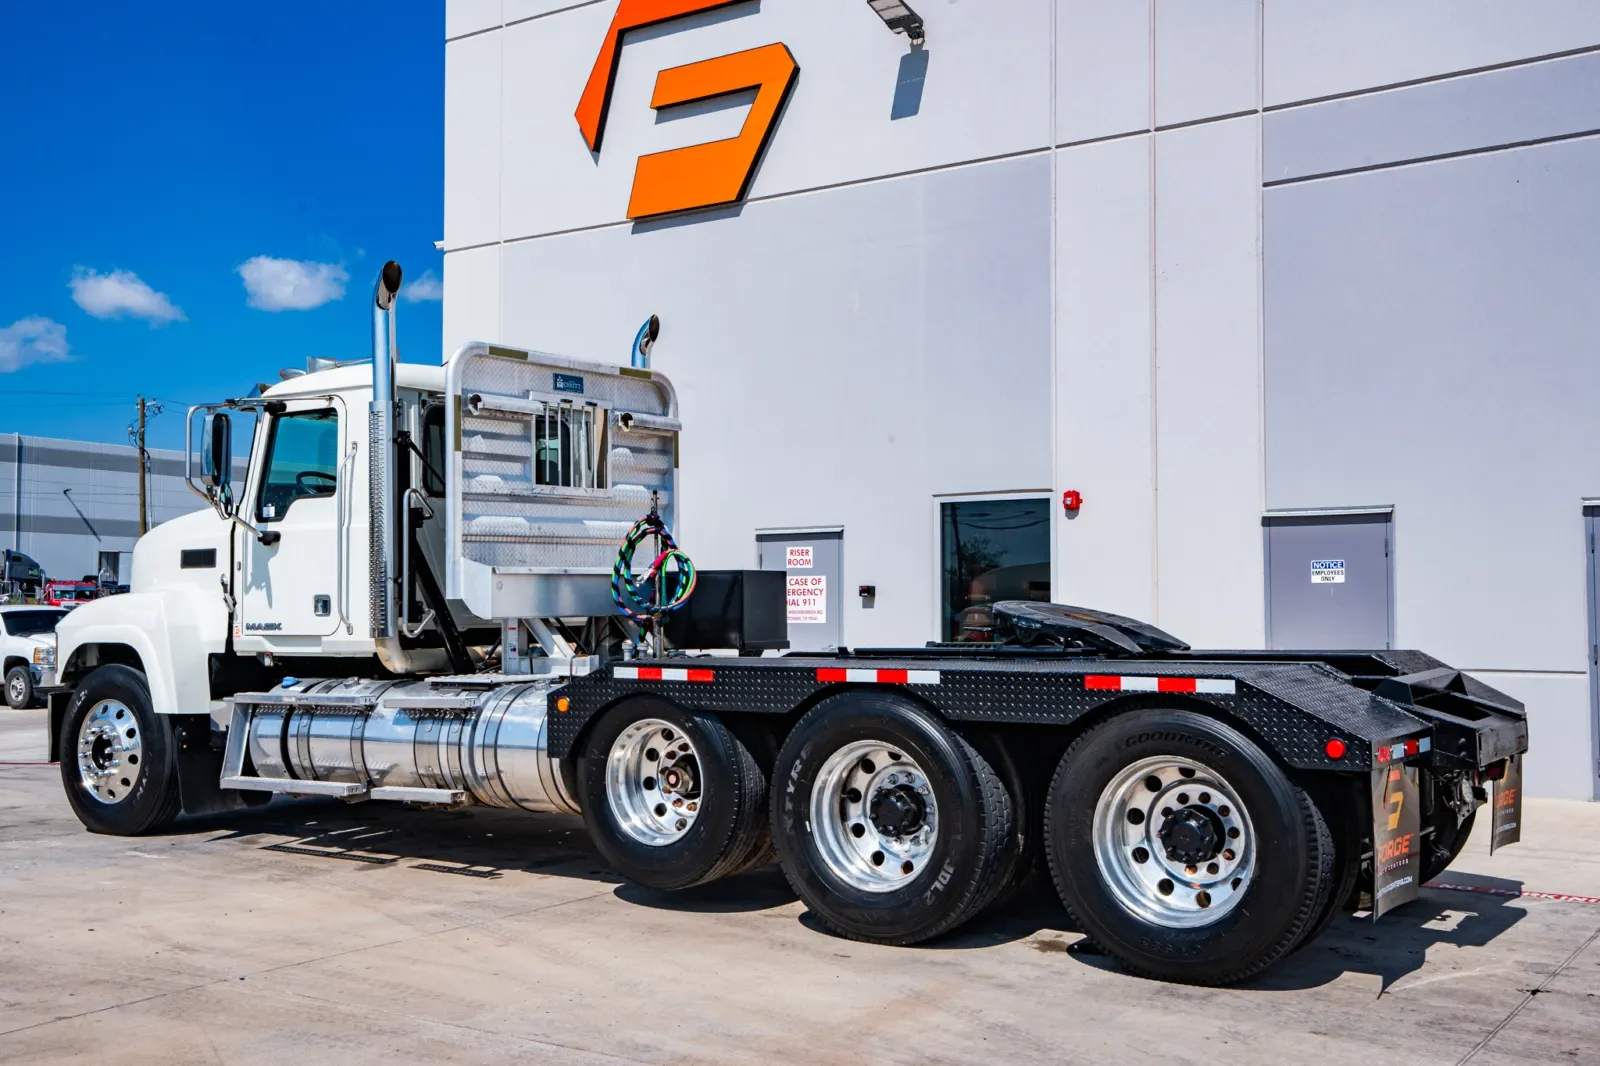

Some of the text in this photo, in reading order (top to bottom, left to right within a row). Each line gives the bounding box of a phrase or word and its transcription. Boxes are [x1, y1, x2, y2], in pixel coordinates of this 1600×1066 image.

[789, 549, 810, 557] RISER
[787, 558, 812, 566] ROOM
[1313, 561, 1343, 569] NOTICE
[788, 578, 823, 586] CASE OF
[787, 588, 824, 596] ERGENCY
[802, 598, 816, 607] 911
